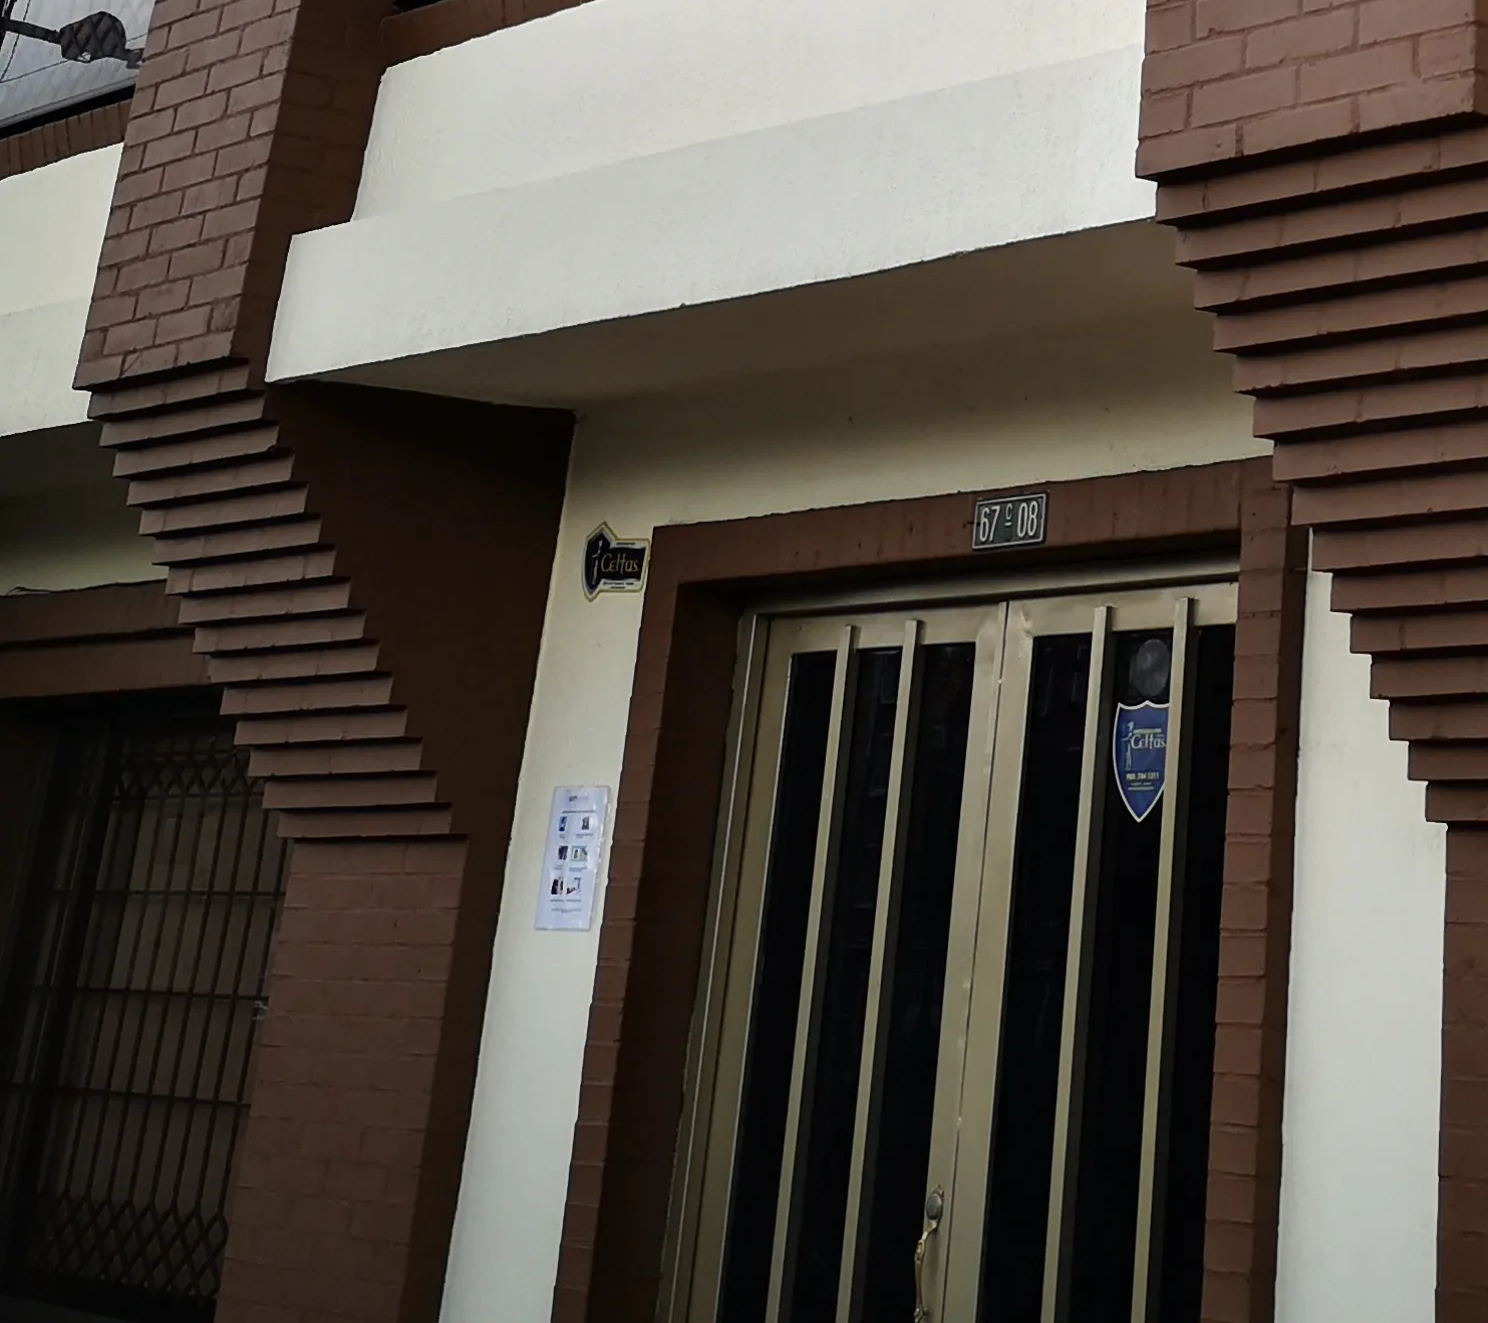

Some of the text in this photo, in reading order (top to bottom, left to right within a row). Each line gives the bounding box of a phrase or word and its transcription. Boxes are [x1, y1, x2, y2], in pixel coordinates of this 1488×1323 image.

[979, 505, 1001, 542] 67
[1017, 500, 1039, 538] 08
[600, 552, 640, 576] Celtas
